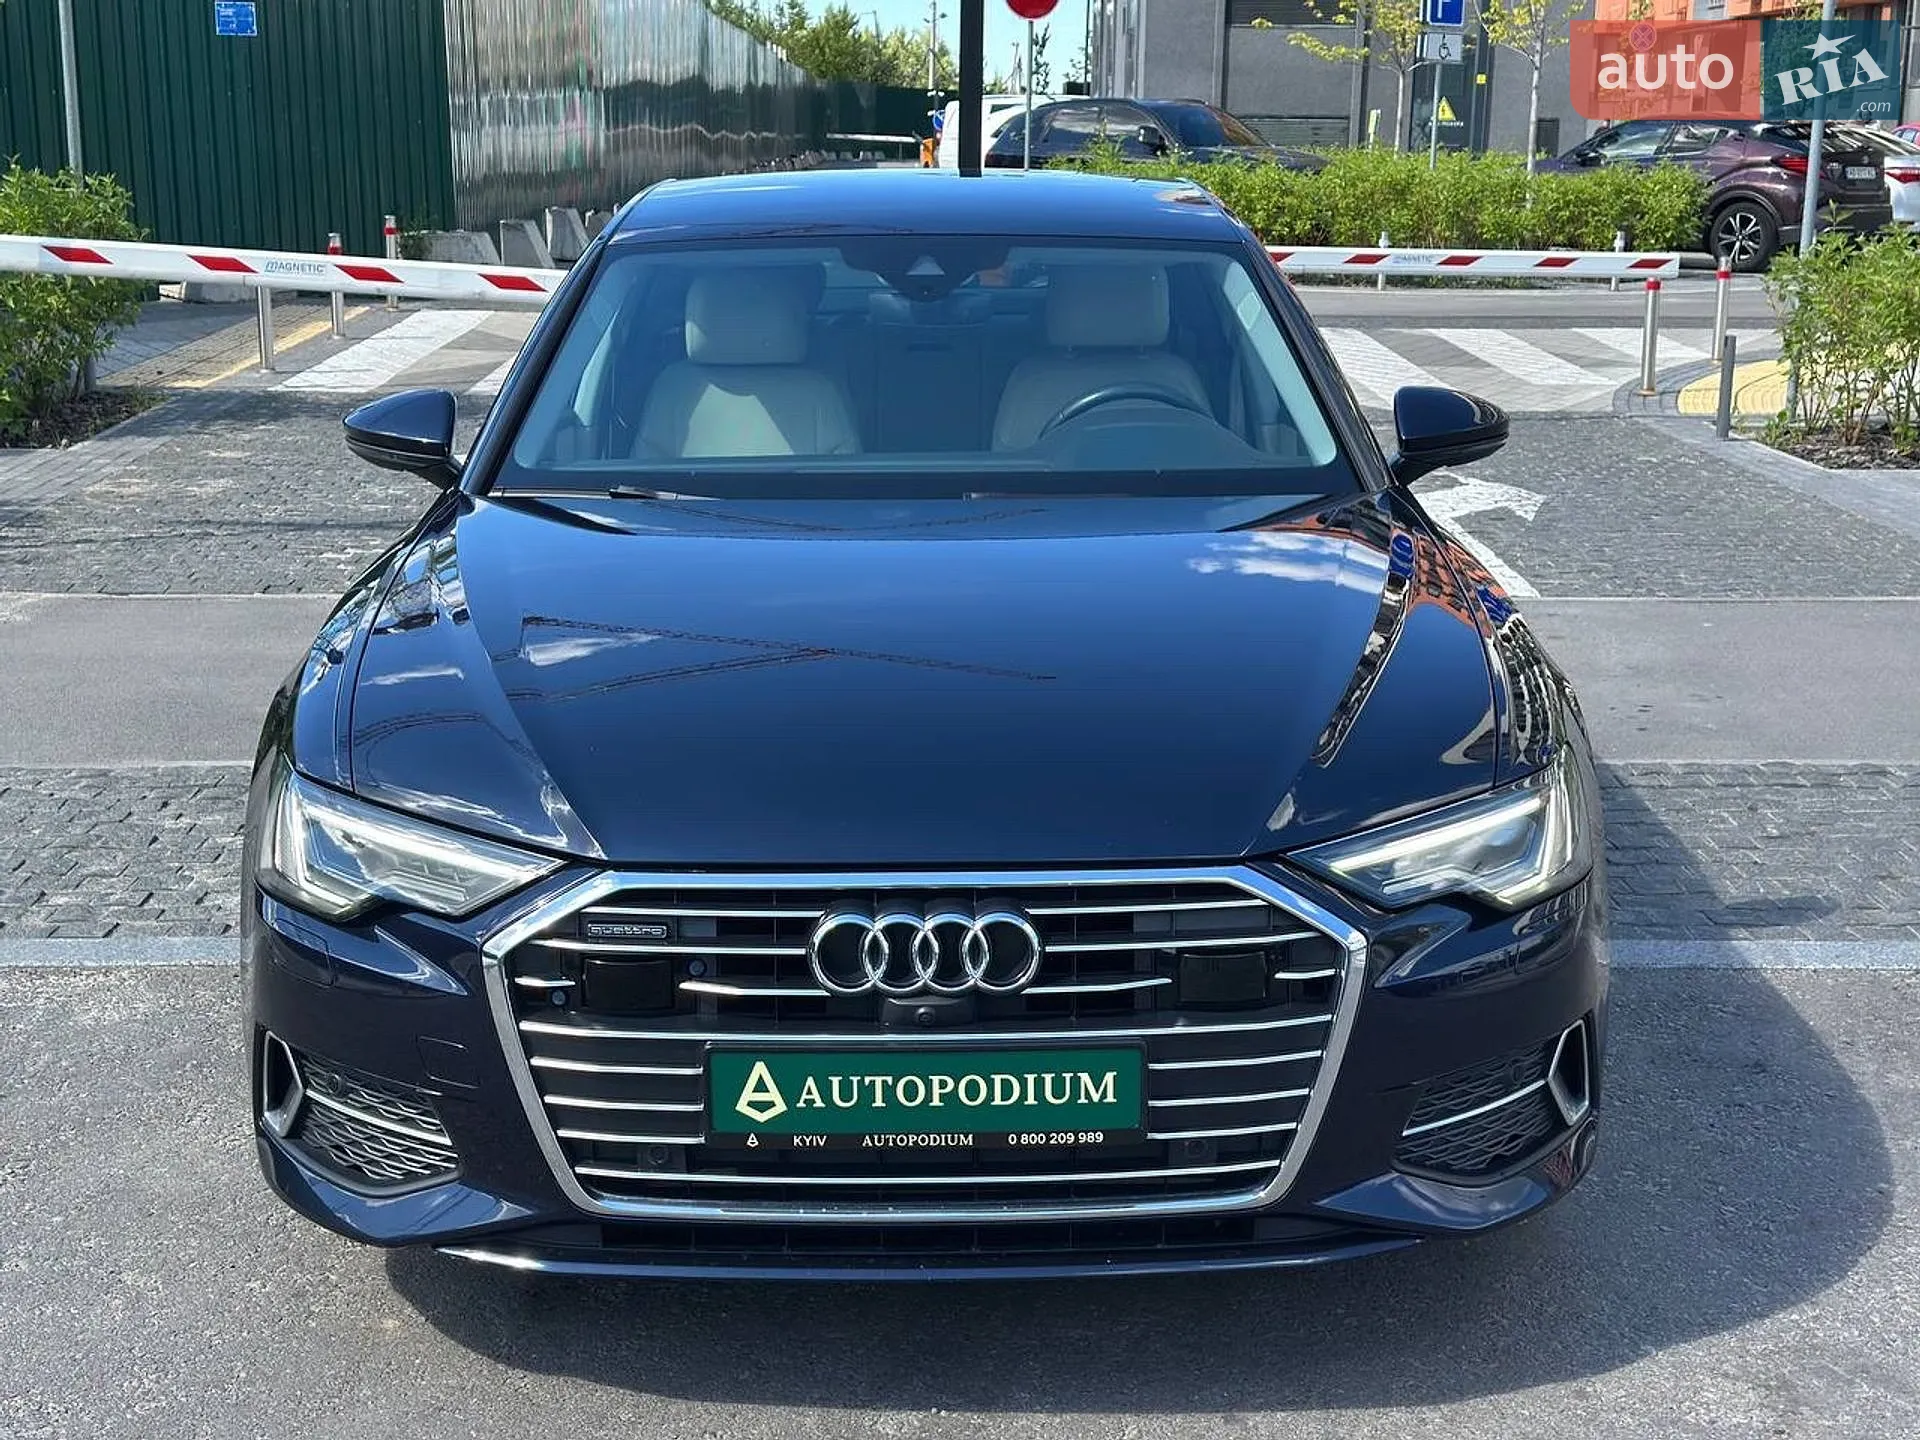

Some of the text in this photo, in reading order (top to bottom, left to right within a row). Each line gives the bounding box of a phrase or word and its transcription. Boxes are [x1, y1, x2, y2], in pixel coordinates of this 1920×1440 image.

[796, 1071, 1118, 1108] AUTOPODIUM
[793, 1131, 1104, 1147] KYIV AUTOPODIUM 0 800 209 989
